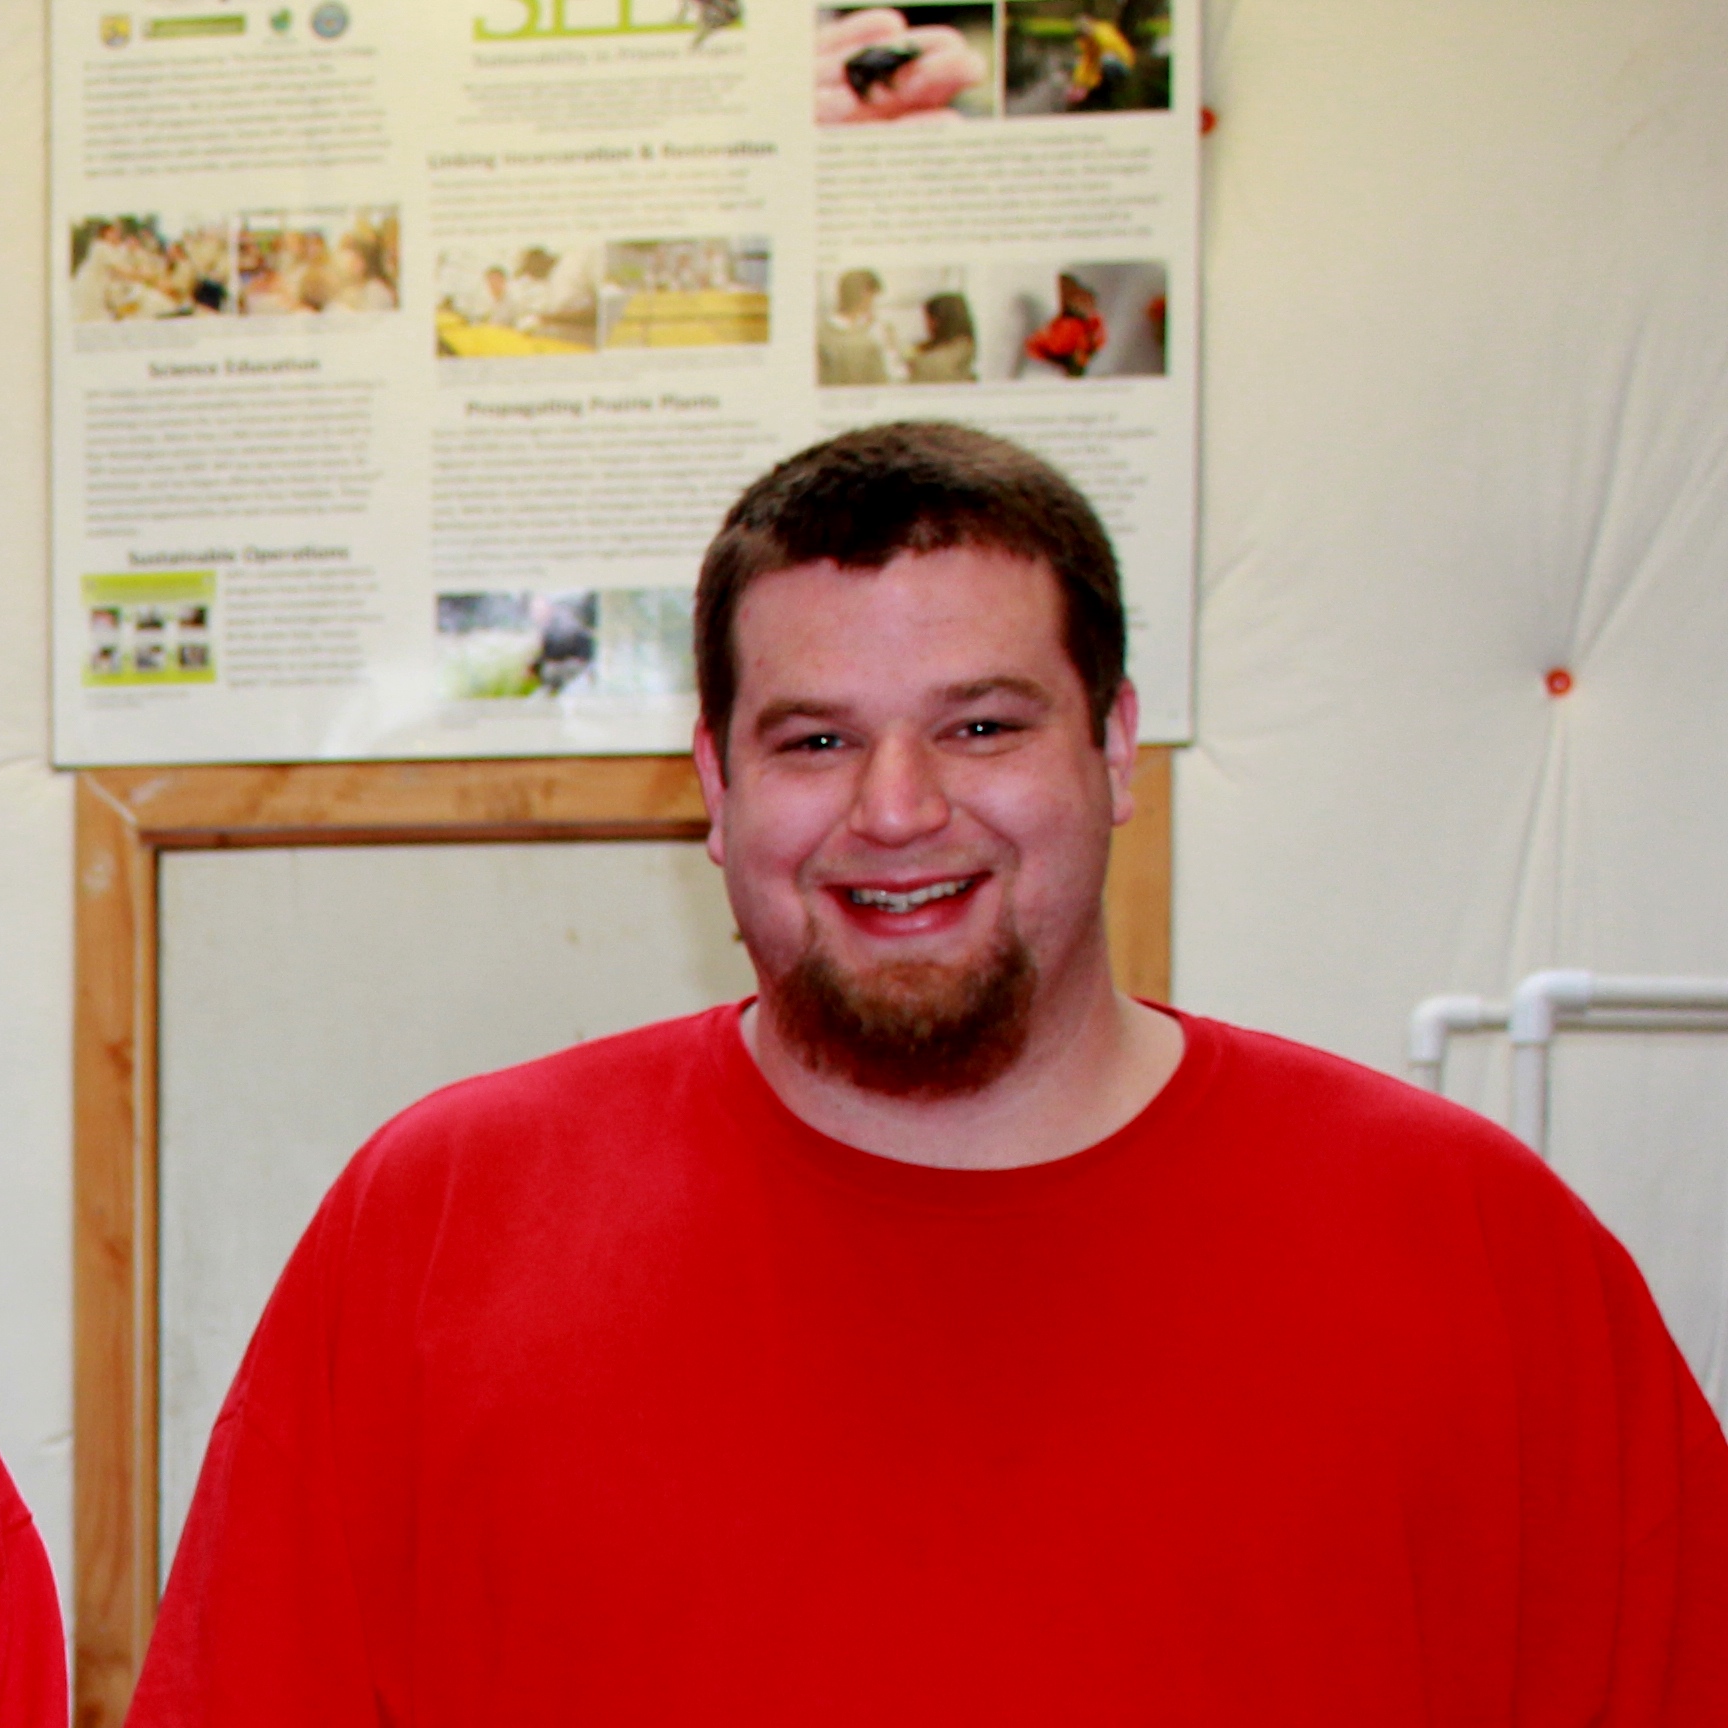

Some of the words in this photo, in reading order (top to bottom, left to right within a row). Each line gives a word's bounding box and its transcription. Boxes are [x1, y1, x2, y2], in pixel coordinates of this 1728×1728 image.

[148, 360, 218, 379] Science
[225, 355, 322, 376] Education
[465, 398, 584, 420] Propagating
[128, 547, 237, 569] Sustainable
[242, 543, 351, 566] Operations
